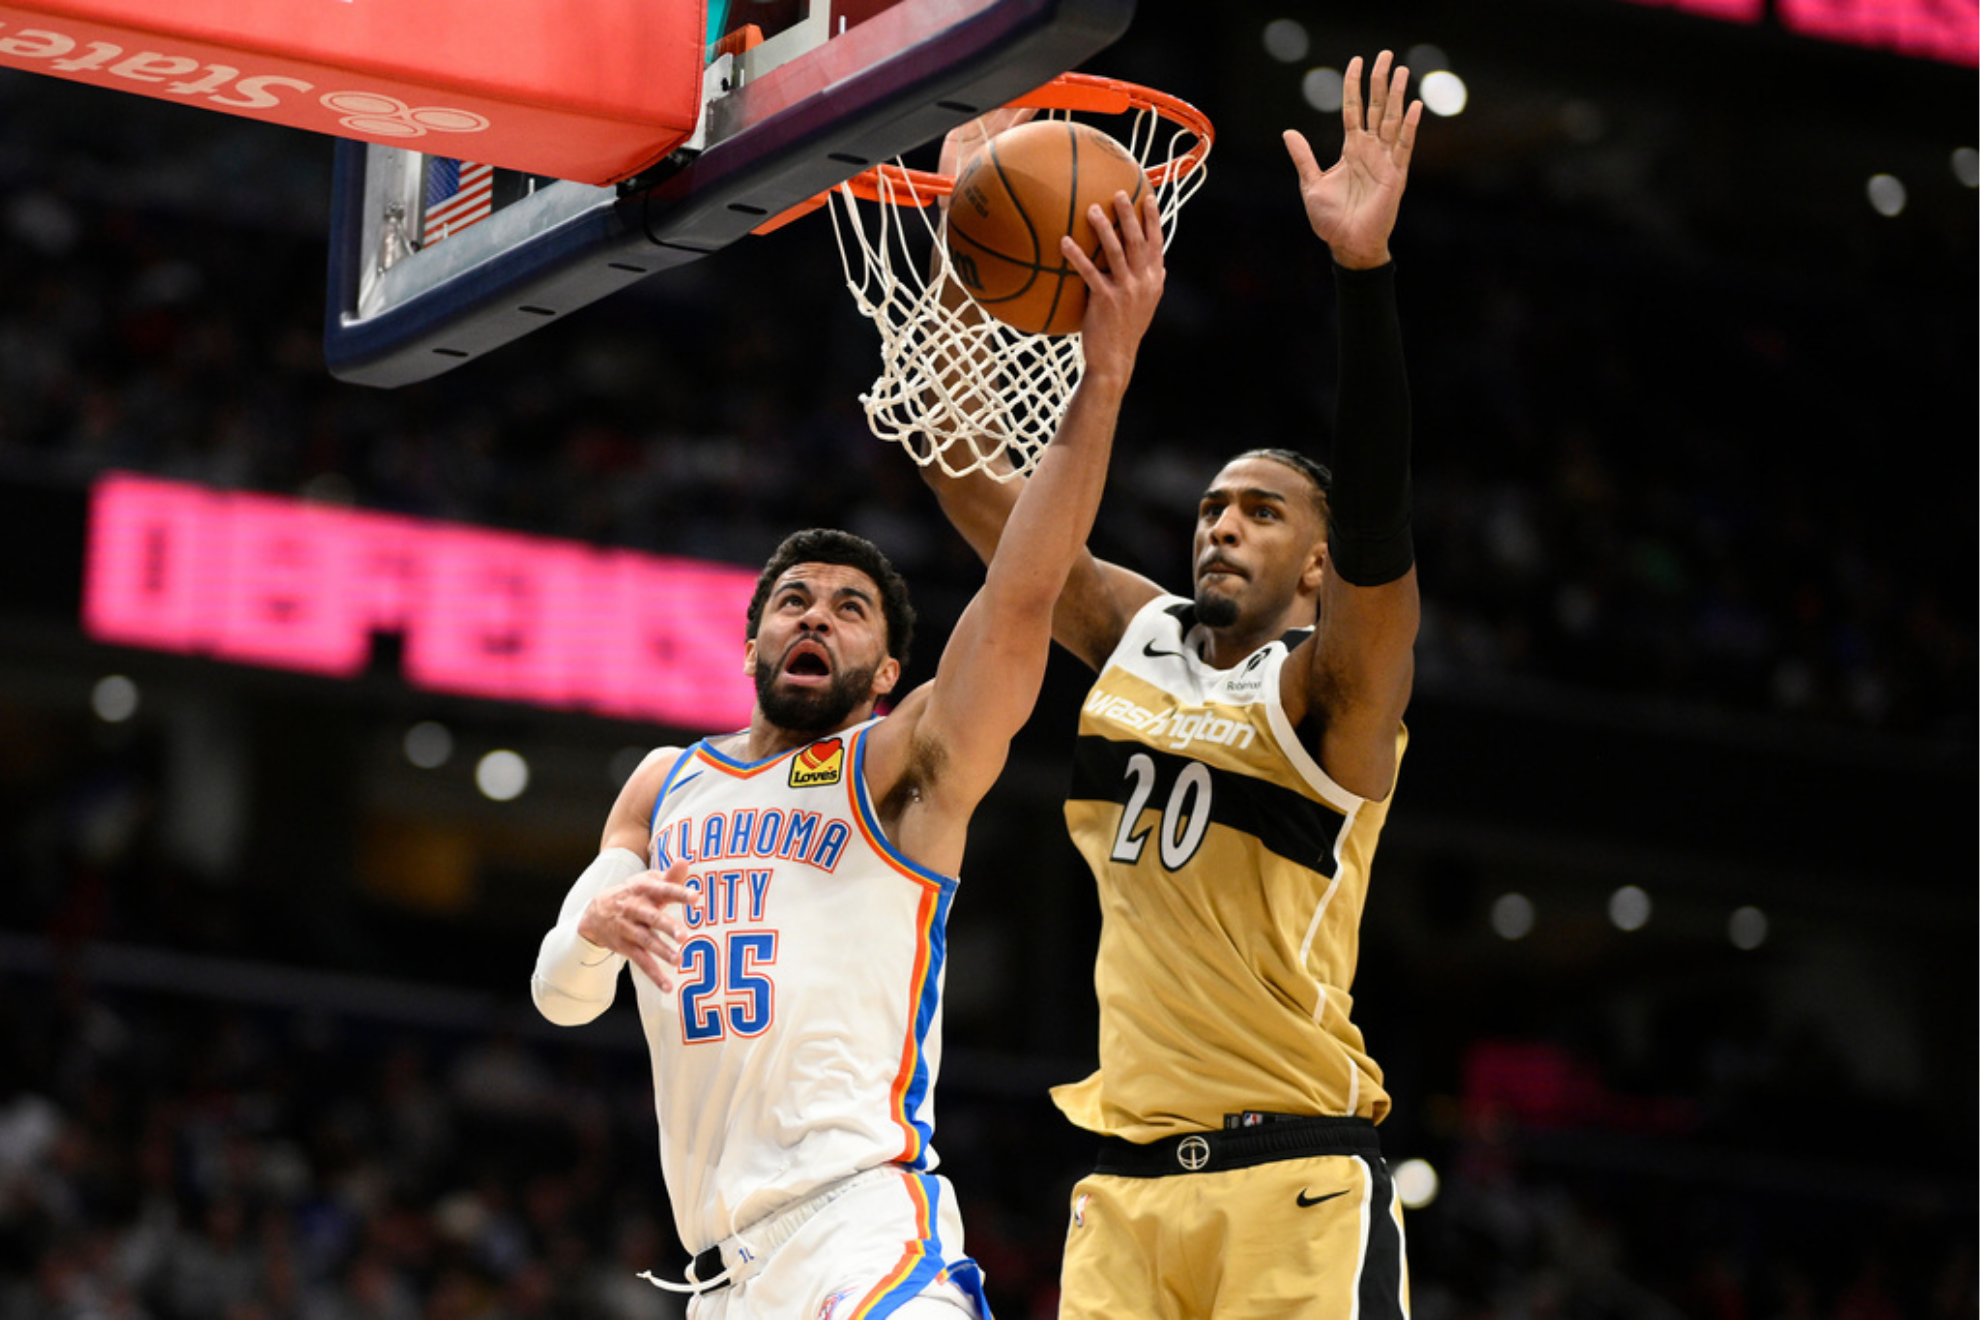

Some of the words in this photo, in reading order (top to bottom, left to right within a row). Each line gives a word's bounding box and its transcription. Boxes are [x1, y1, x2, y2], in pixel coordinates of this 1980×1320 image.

[0, 28, 315, 109] State
[82, 470, 758, 732] DEFENS
[794, 766, 838, 783] Love's
[1110, 752, 1213, 873] 20
[651, 807, 853, 875] KLAHOMA
[683, 868, 774, 930] CITY
[678, 929, 779, 1045] 25
